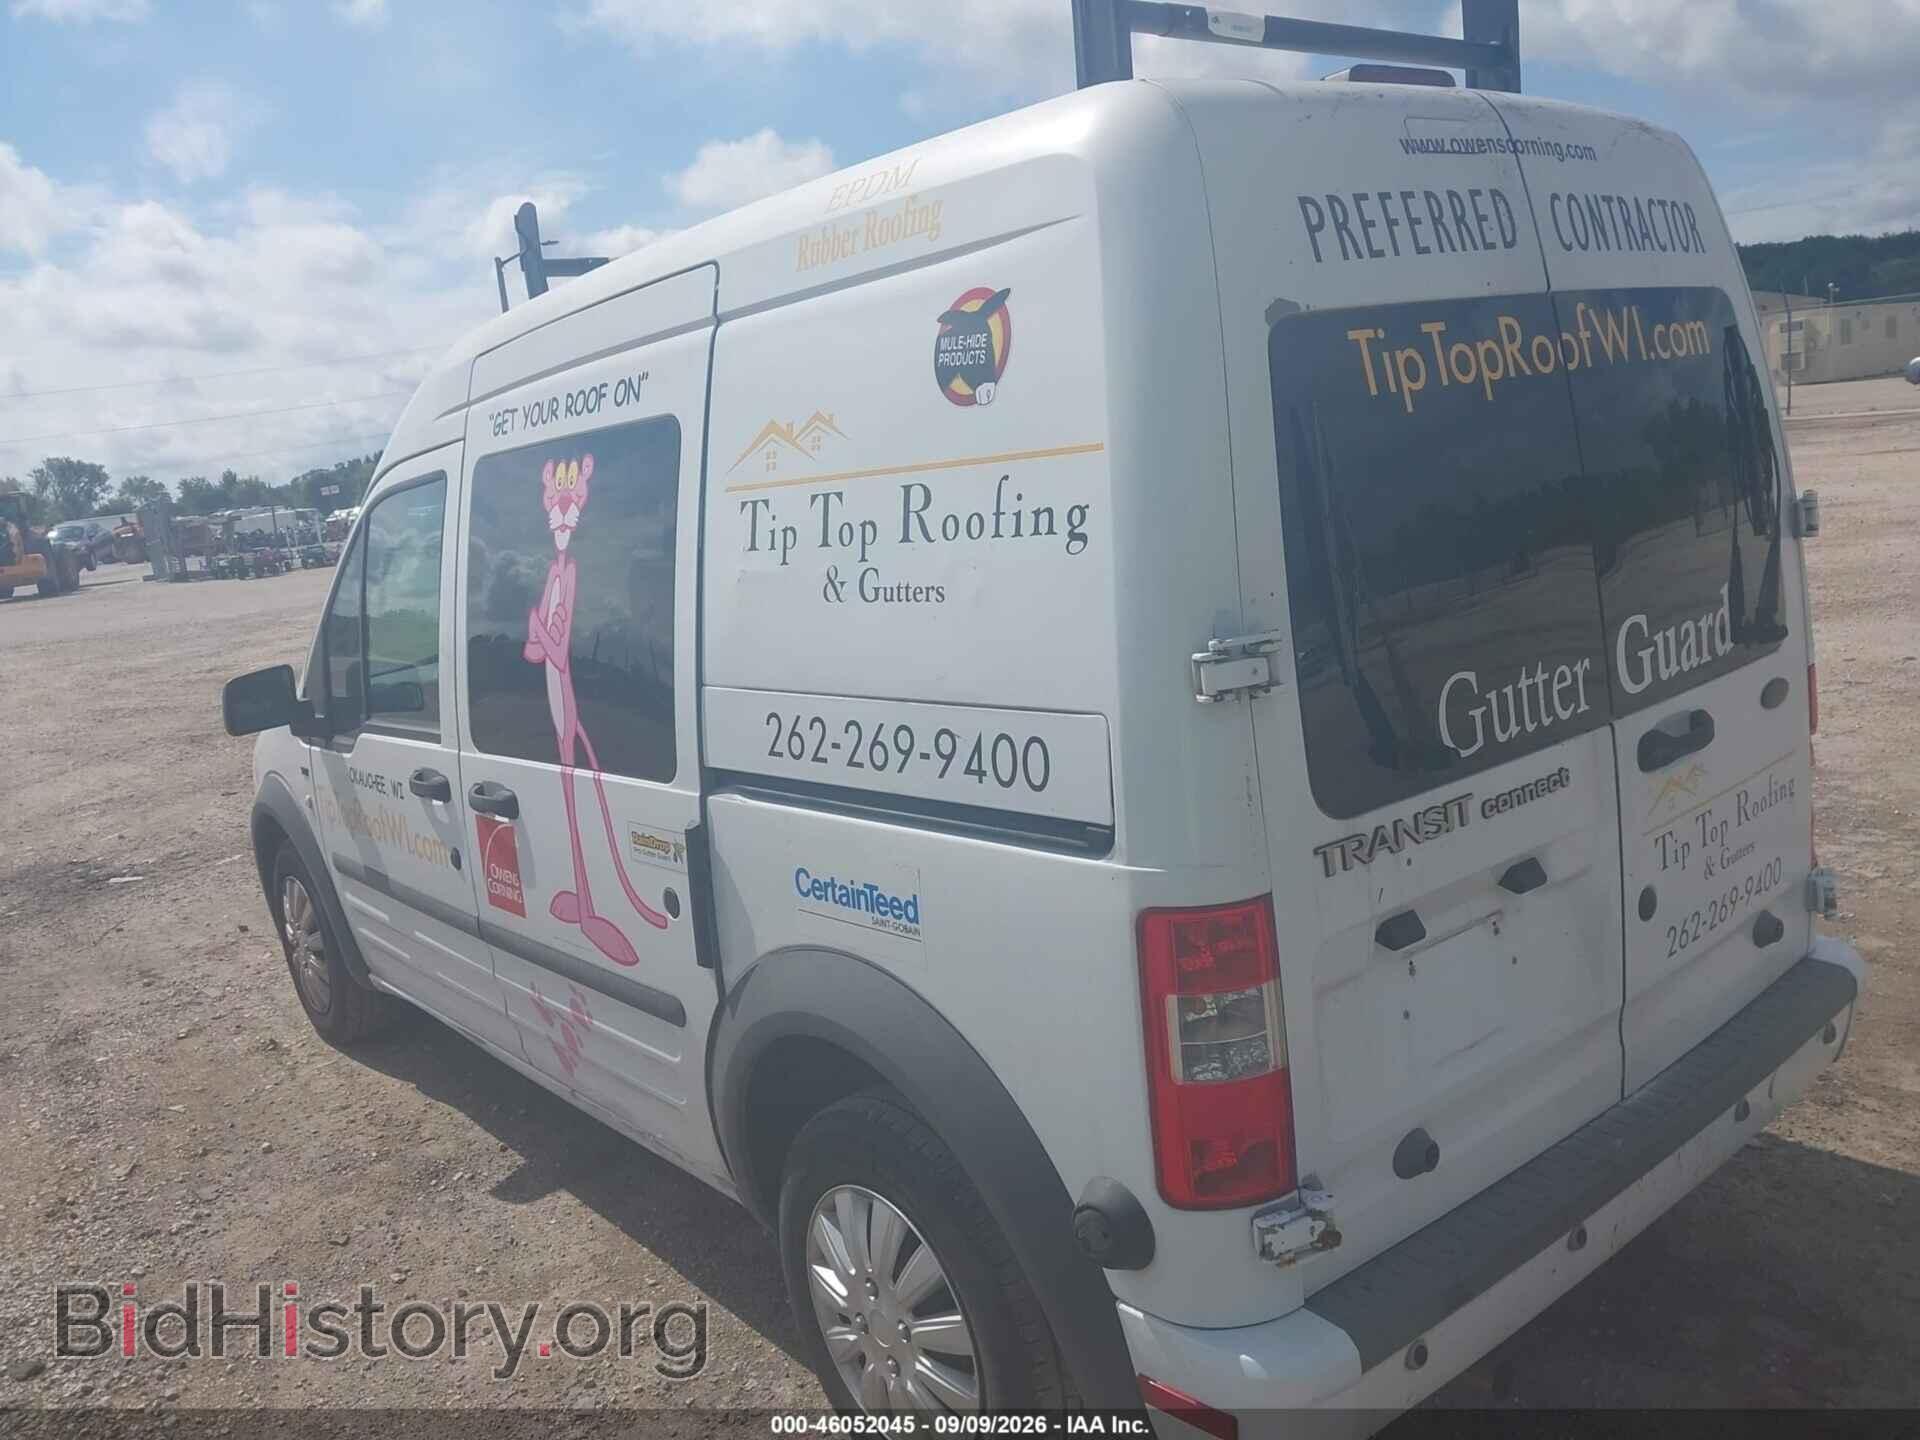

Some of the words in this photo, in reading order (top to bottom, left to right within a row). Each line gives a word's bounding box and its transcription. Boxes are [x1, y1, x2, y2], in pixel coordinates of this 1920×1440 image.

[825, 159, 919, 213] EPDM
[1400, 136, 1597, 162] www.owenscorning.com
[795, 226, 857, 272] Rubber
[864, 196, 944, 249] Roofing
[1298, 188, 1517, 263] PREFERRED
[1550, 192, 1706, 254] CONTRACTOR
[938, 350, 986, 367] PRODUCTS
[940, 333, 988, 351] MULE-HIDE
[1347, 302, 1711, 414] TipTopRoofWI.com
[522, 396, 560, 431] YOUR
[565, 383, 608, 419] ROOF
[740, 498, 798, 566] Tip
[809, 491, 878, 563] Top
[898, 475, 1090, 555] Roofing
[823, 565, 848, 603] &
[859, 567, 946, 603] Gutters
[1439, 655, 1591, 758] Gutter
[1615, 584, 1735, 695] Guard
[765, 711, 1051, 793] 262-269-9400
[1313, 793, 1473, 878] TRANSIT
[1481, 767, 1570, 820] connect
[1654, 830, 1690, 871] Tip
[1695, 808, 1728, 849] Top
[1736, 773, 1795, 827] Roofing
[795, 867, 919, 925] CertainTeed
[1704, 856, 1716, 880] &
[1720, 841, 1755, 870] Gutters
[1667, 857, 1782, 958] 262-269-9400
